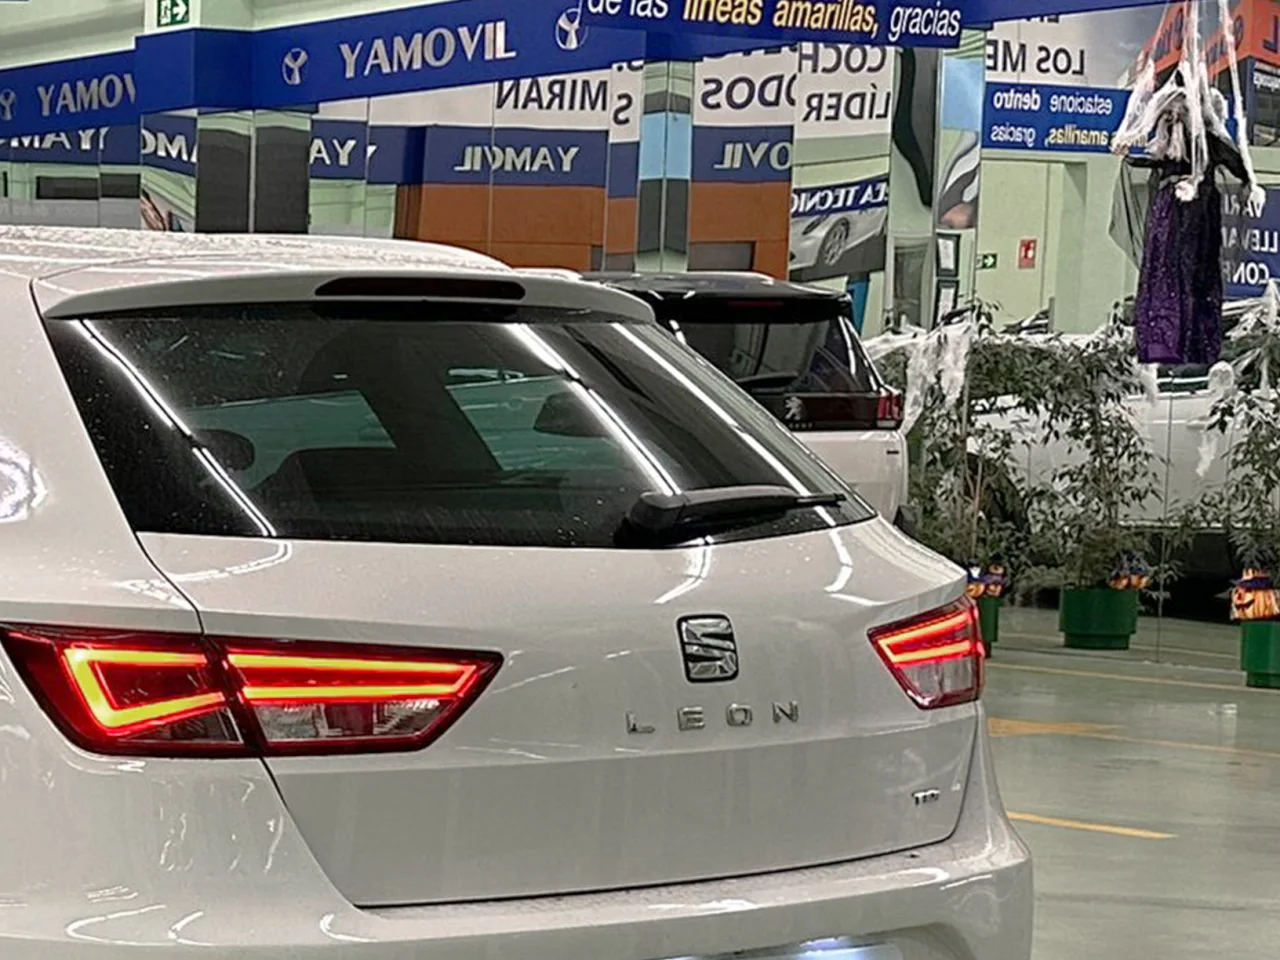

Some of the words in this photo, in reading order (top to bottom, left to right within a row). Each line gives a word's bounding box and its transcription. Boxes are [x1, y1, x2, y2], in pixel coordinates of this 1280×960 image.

[773, 0, 879, 37] amarillas,
[889, 6, 962, 41] gracias
[340, 20, 516, 79] YAMOVIL
[626, 701, 799, 735] LEON
